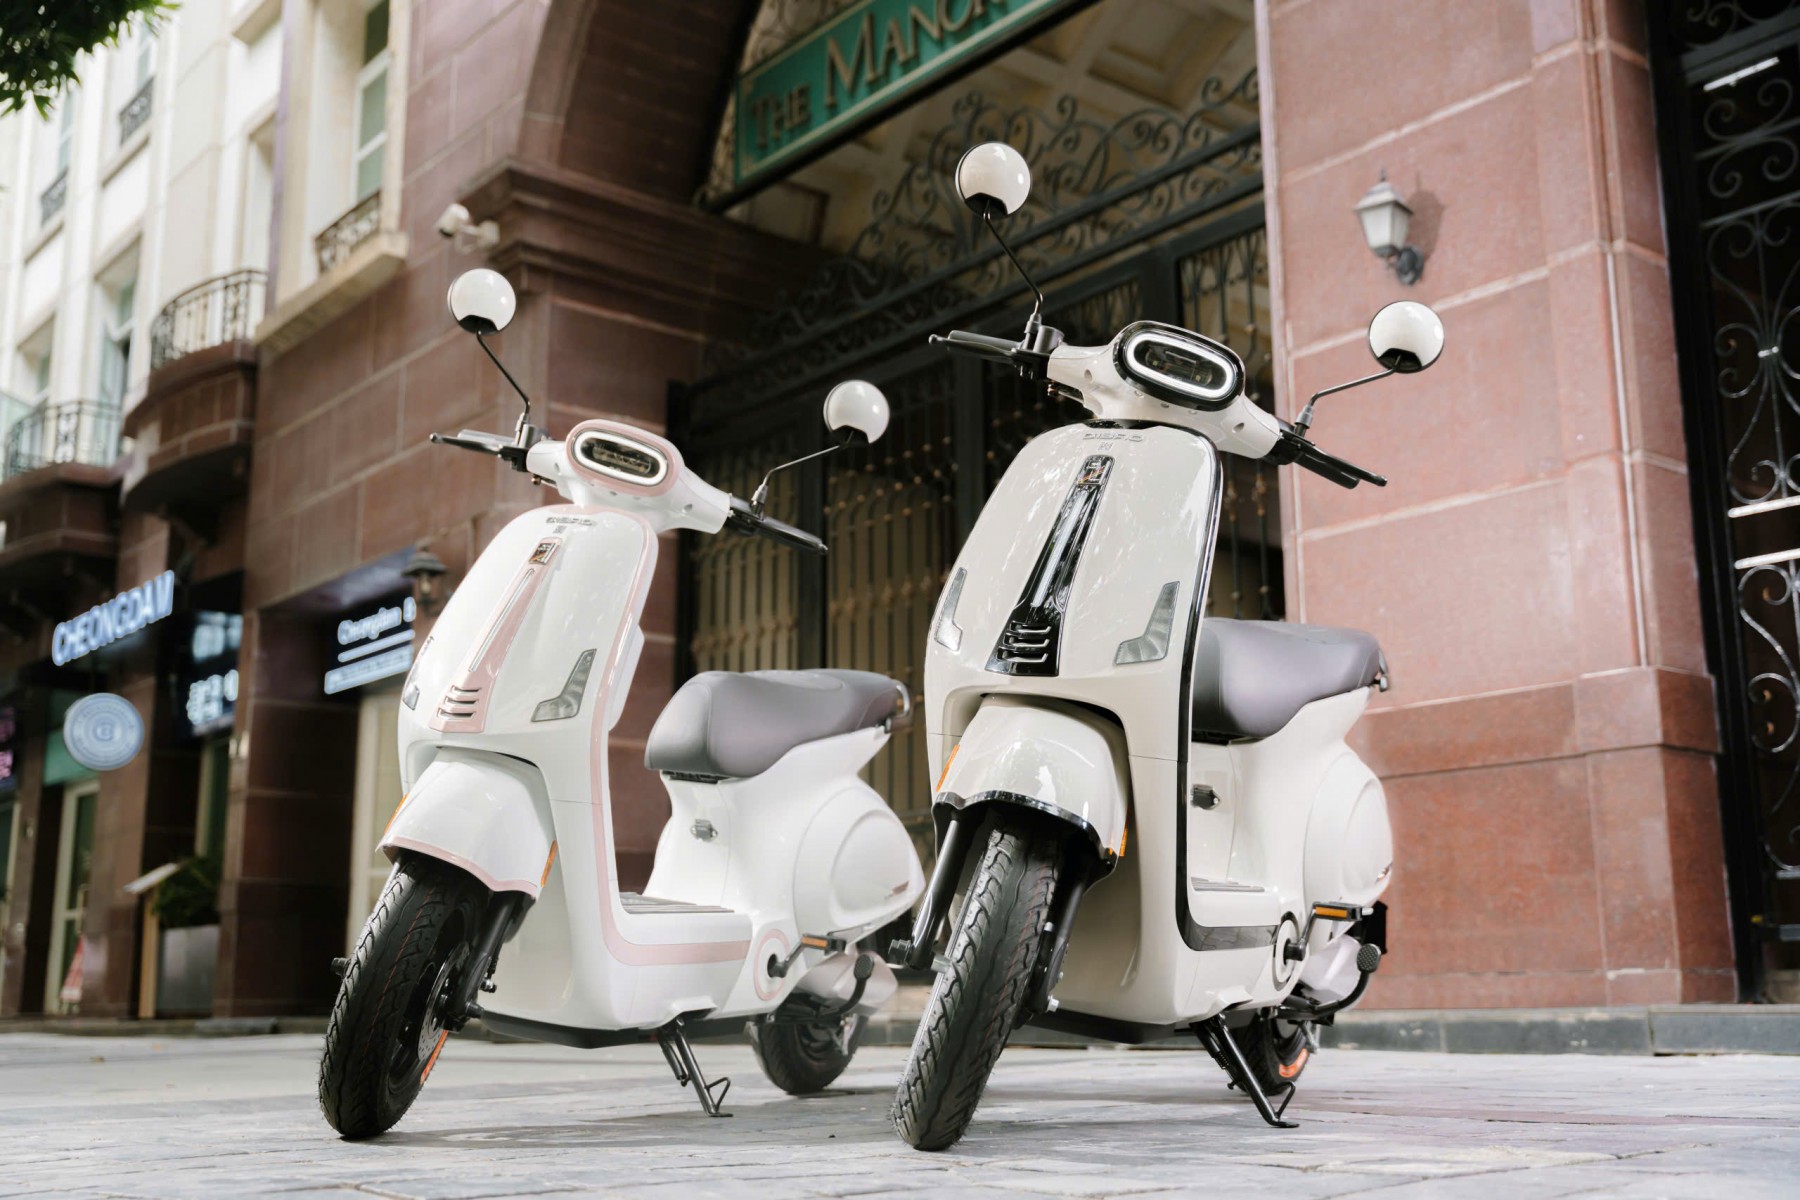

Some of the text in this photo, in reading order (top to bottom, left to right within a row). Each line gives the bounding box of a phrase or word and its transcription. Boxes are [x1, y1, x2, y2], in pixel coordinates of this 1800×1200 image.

[753, 0, 1006, 147] THE MANO
[52, 570, 174, 667] CHEONGDAM
